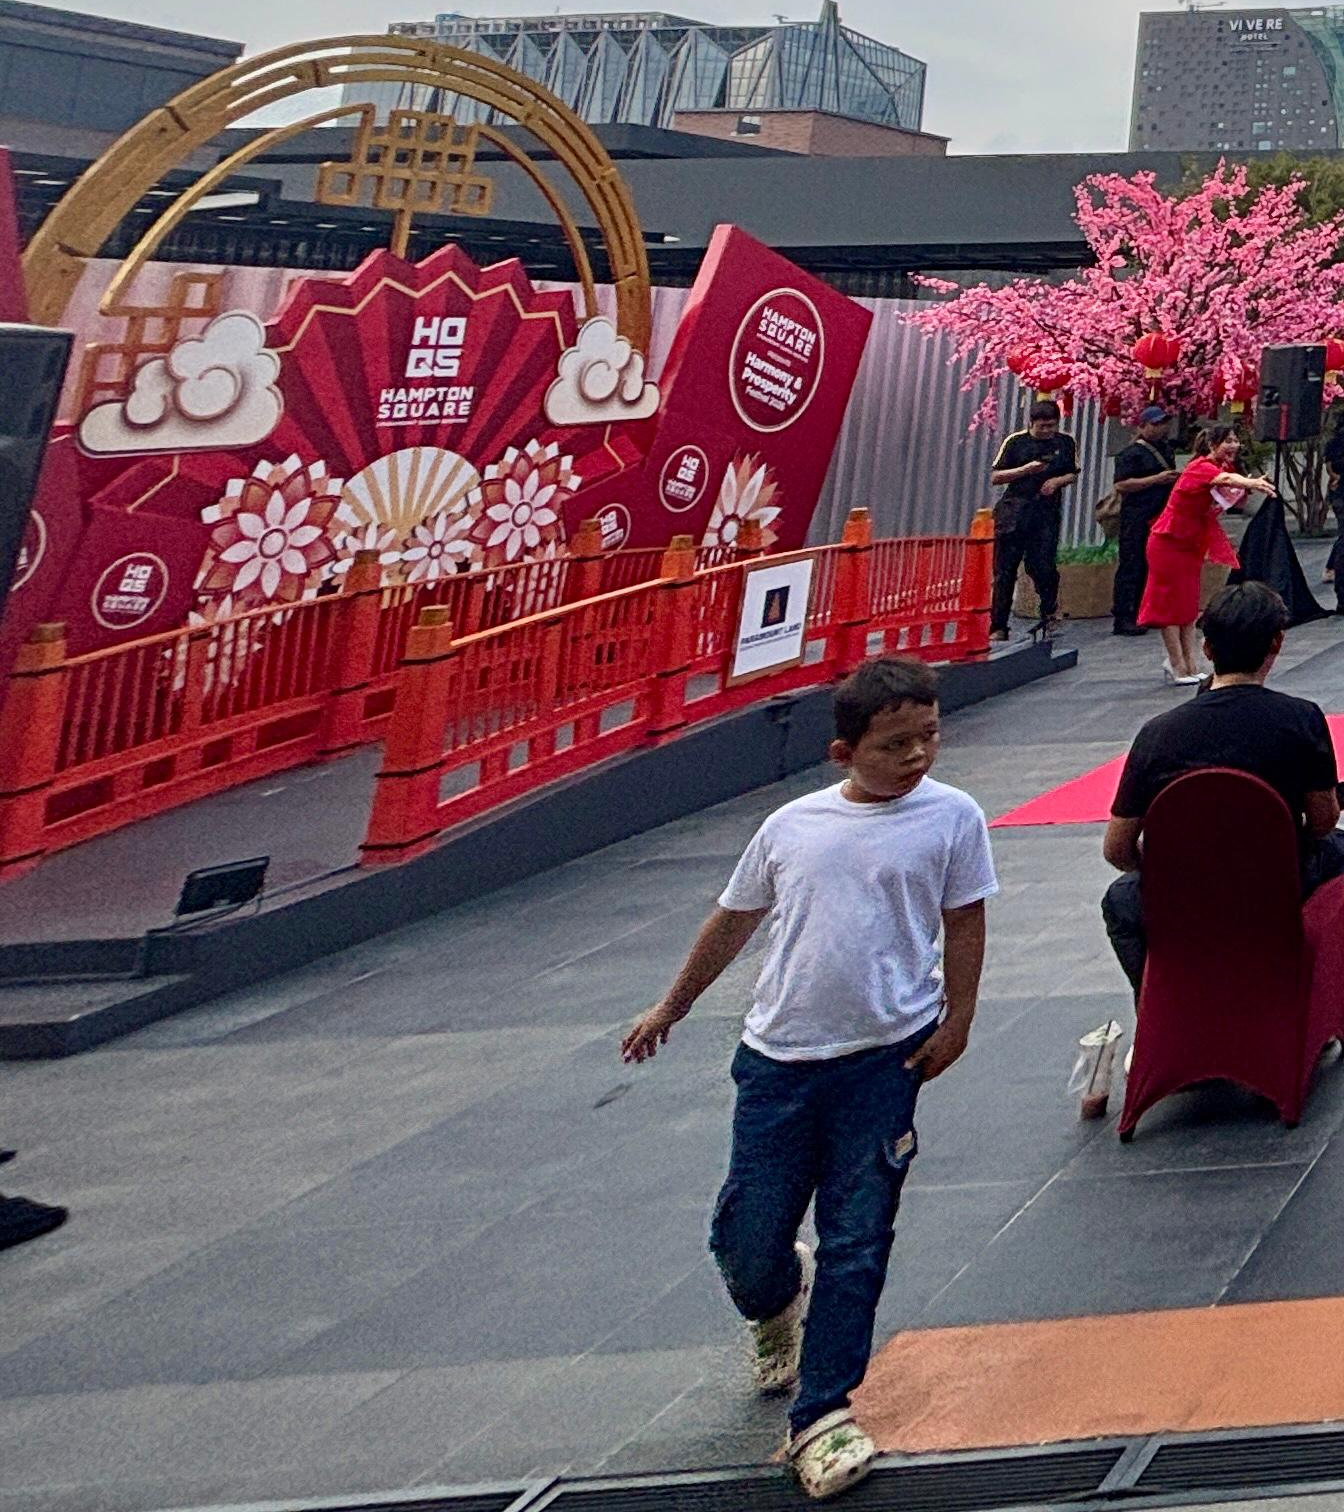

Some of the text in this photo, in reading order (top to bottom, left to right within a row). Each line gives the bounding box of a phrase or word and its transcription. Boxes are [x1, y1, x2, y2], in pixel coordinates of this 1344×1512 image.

[411, 316, 467, 346] HO
[758, 319, 813, 357] SQUARE
[761, 306, 817, 345] HAMPTON
[405, 348, 465, 377] QS
[744, 351, 794, 388] Harmony
[380, 386, 474, 403] HAMPTON
[741, 366, 797, 406] Prosperity
[376, 401, 472, 419] SQUARE
